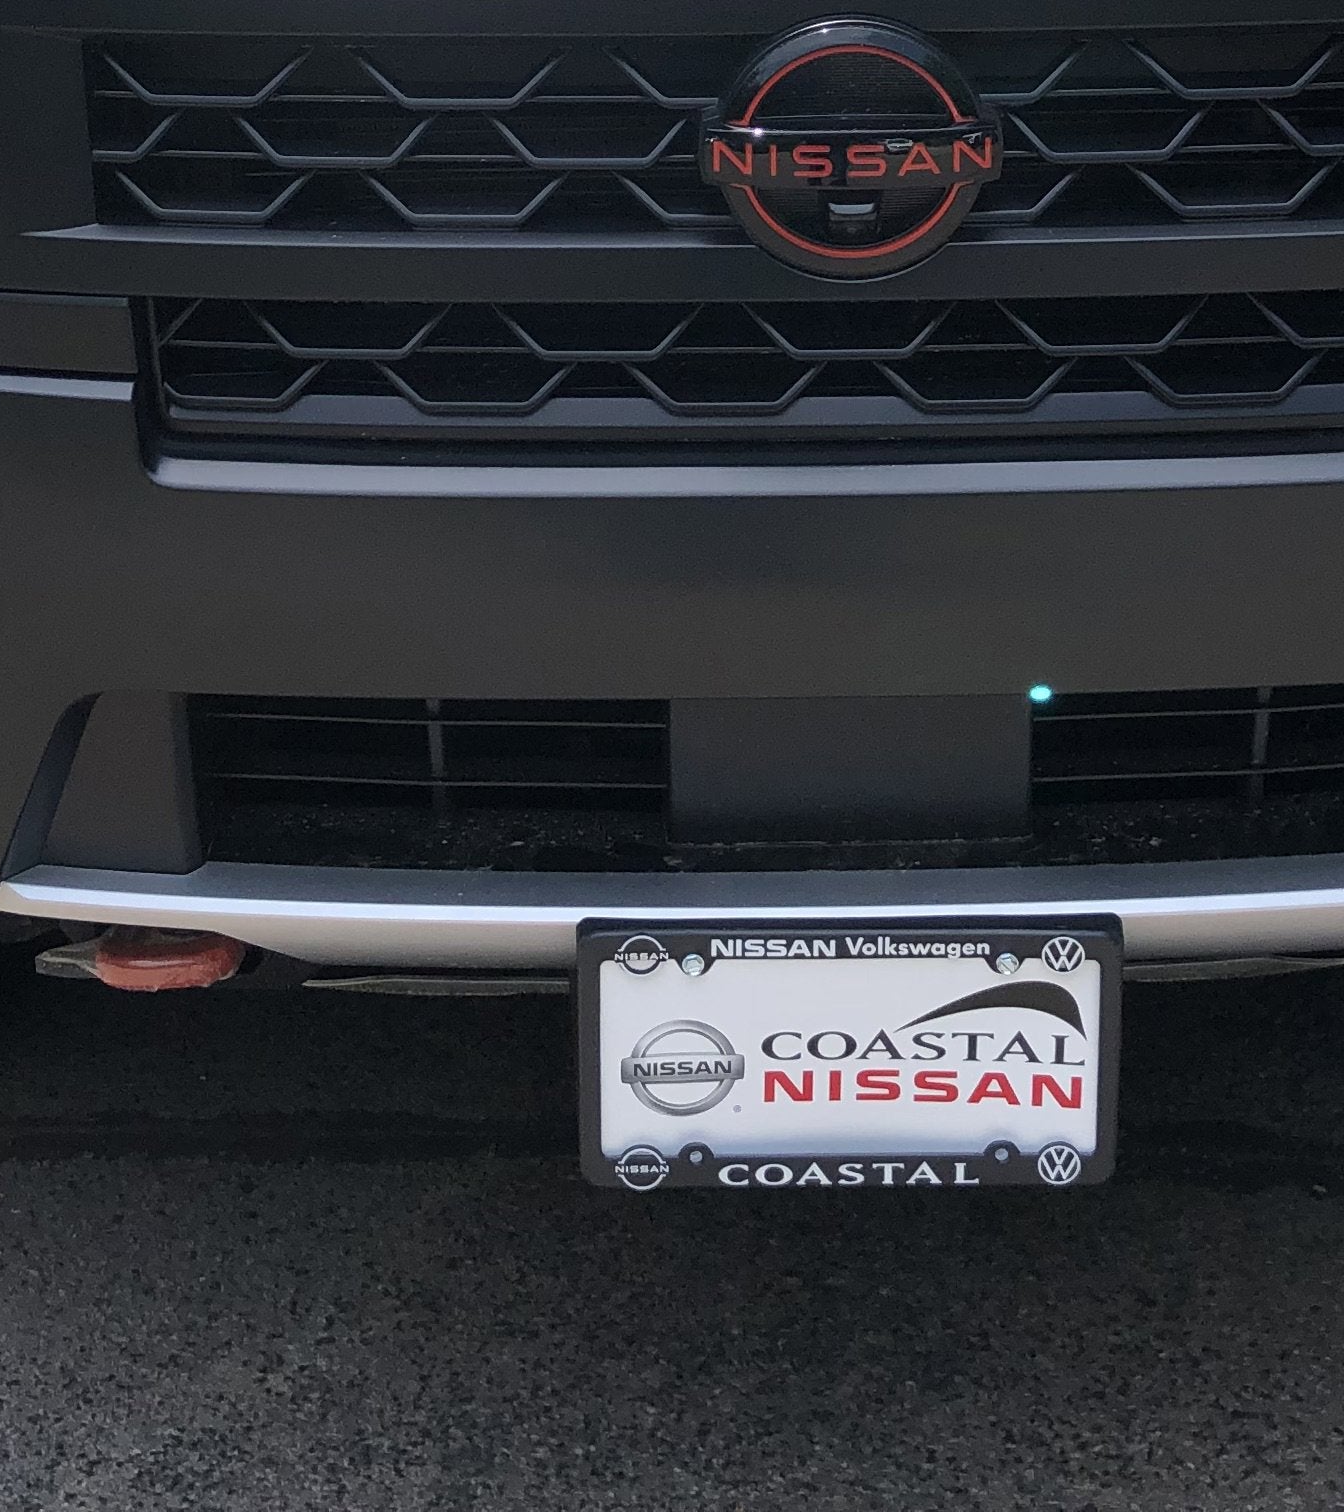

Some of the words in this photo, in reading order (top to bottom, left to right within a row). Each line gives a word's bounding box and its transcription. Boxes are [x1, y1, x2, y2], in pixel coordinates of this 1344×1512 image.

[712, 137, 992, 177] NISSAN
[614, 952, 669, 962] NISSAN
[711, 938, 836, 958] NISSAN
[846, 936, 990, 959] Volkswagen
[761, 1029, 1086, 1065] COASTAL
[633, 1060, 732, 1077] NISSAN
[763, 1070, 1082, 1108] NISSAN
[614, 1164, 670, 1174] NISSAN
[718, 1162, 979, 1186] COASTAL
